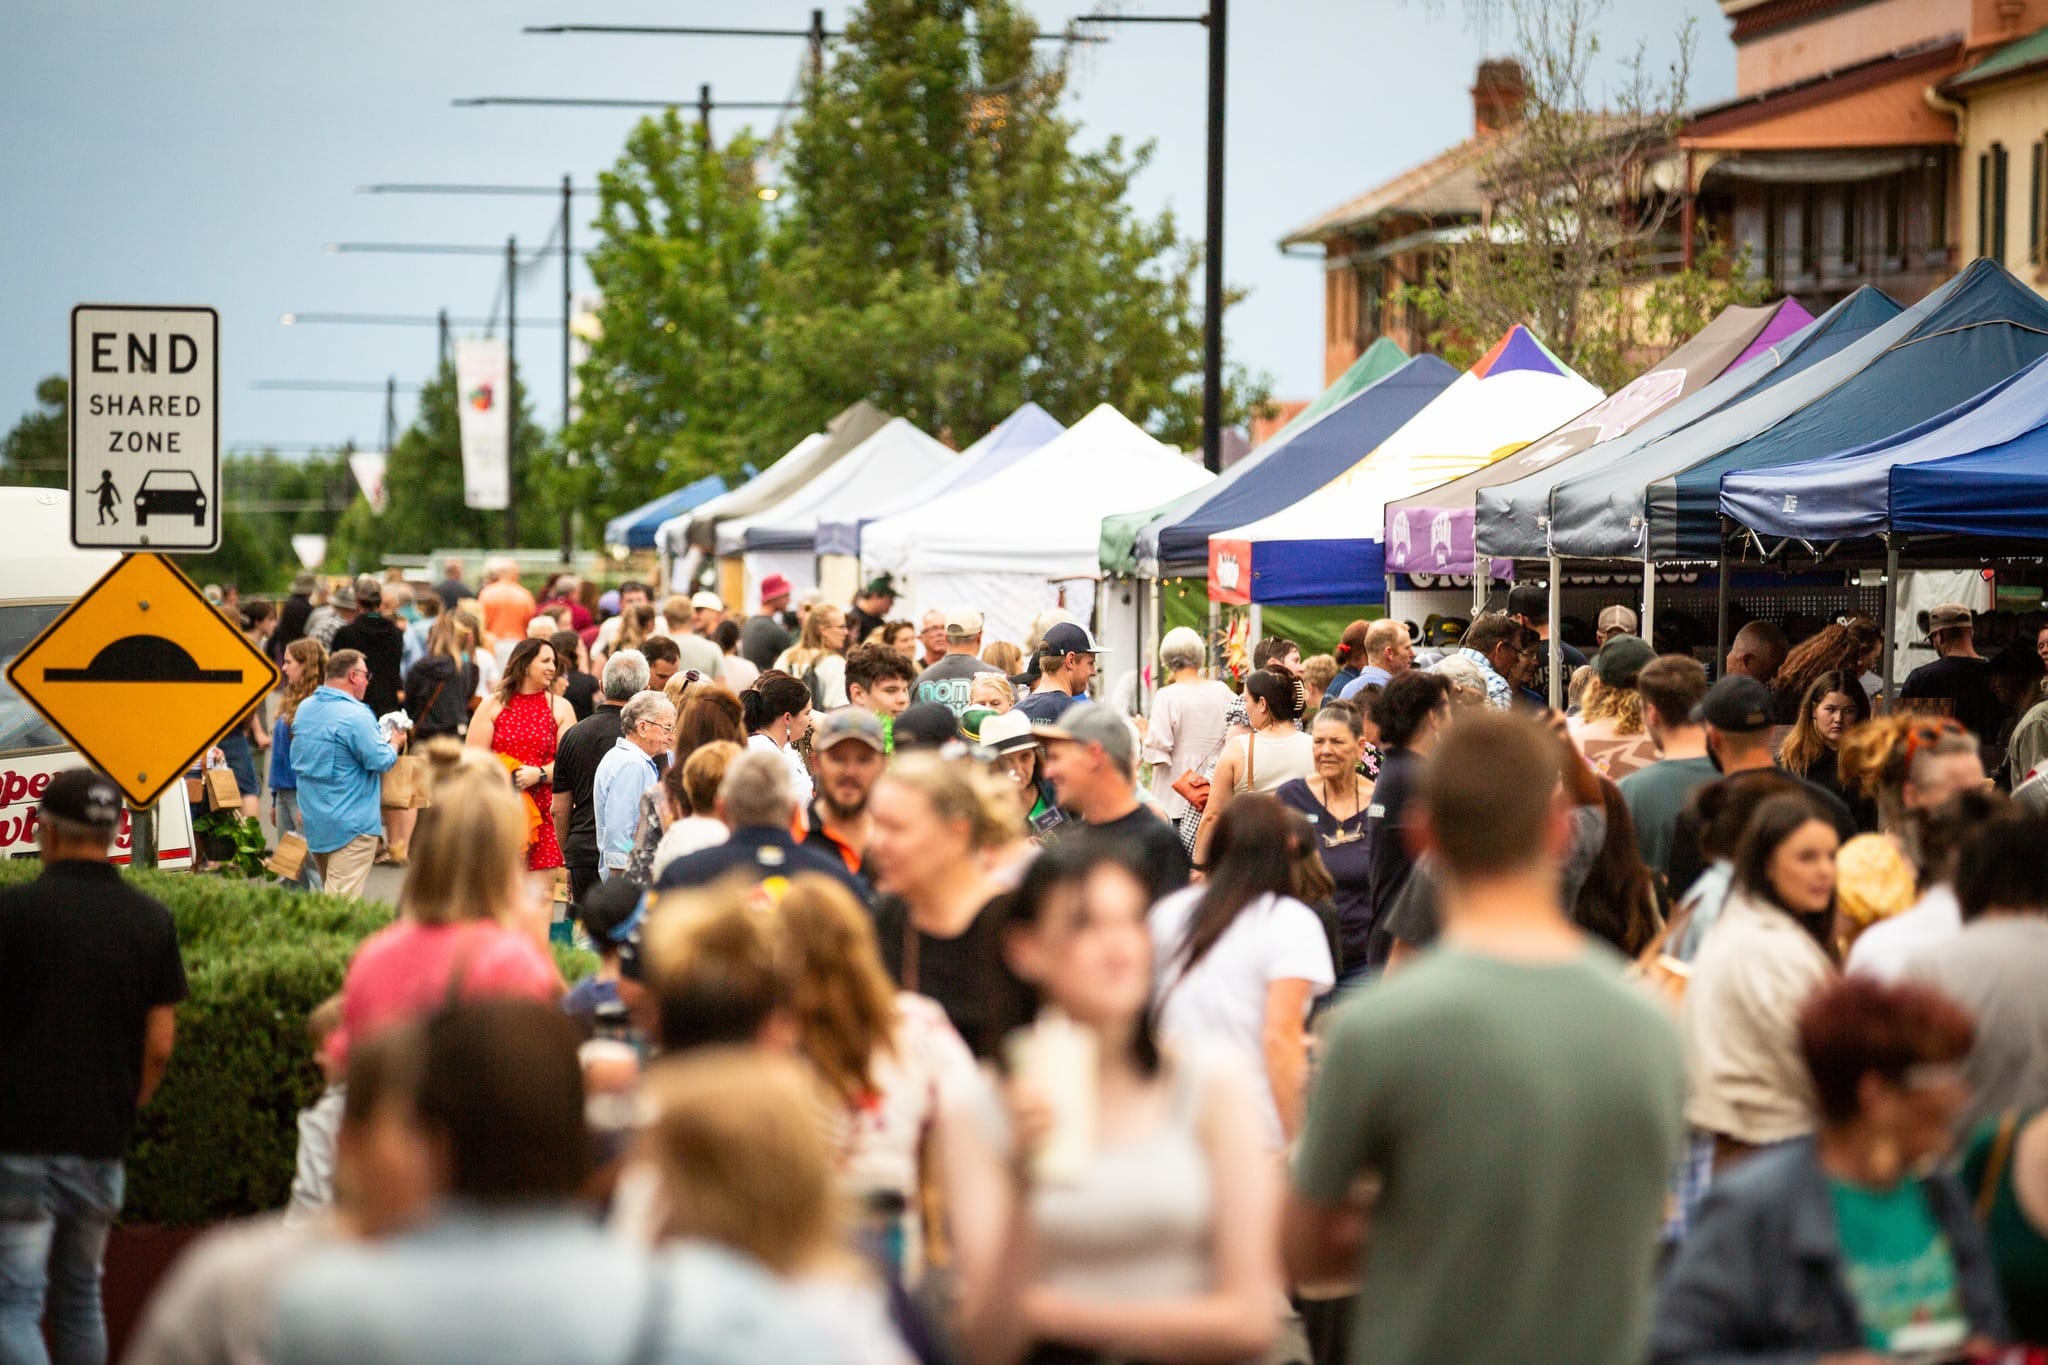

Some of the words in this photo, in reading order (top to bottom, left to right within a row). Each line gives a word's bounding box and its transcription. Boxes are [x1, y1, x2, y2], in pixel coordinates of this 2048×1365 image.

[92, 332, 198, 374] END
[89, 394, 200, 417] SHARED
[108, 431, 181, 453] ZONE
